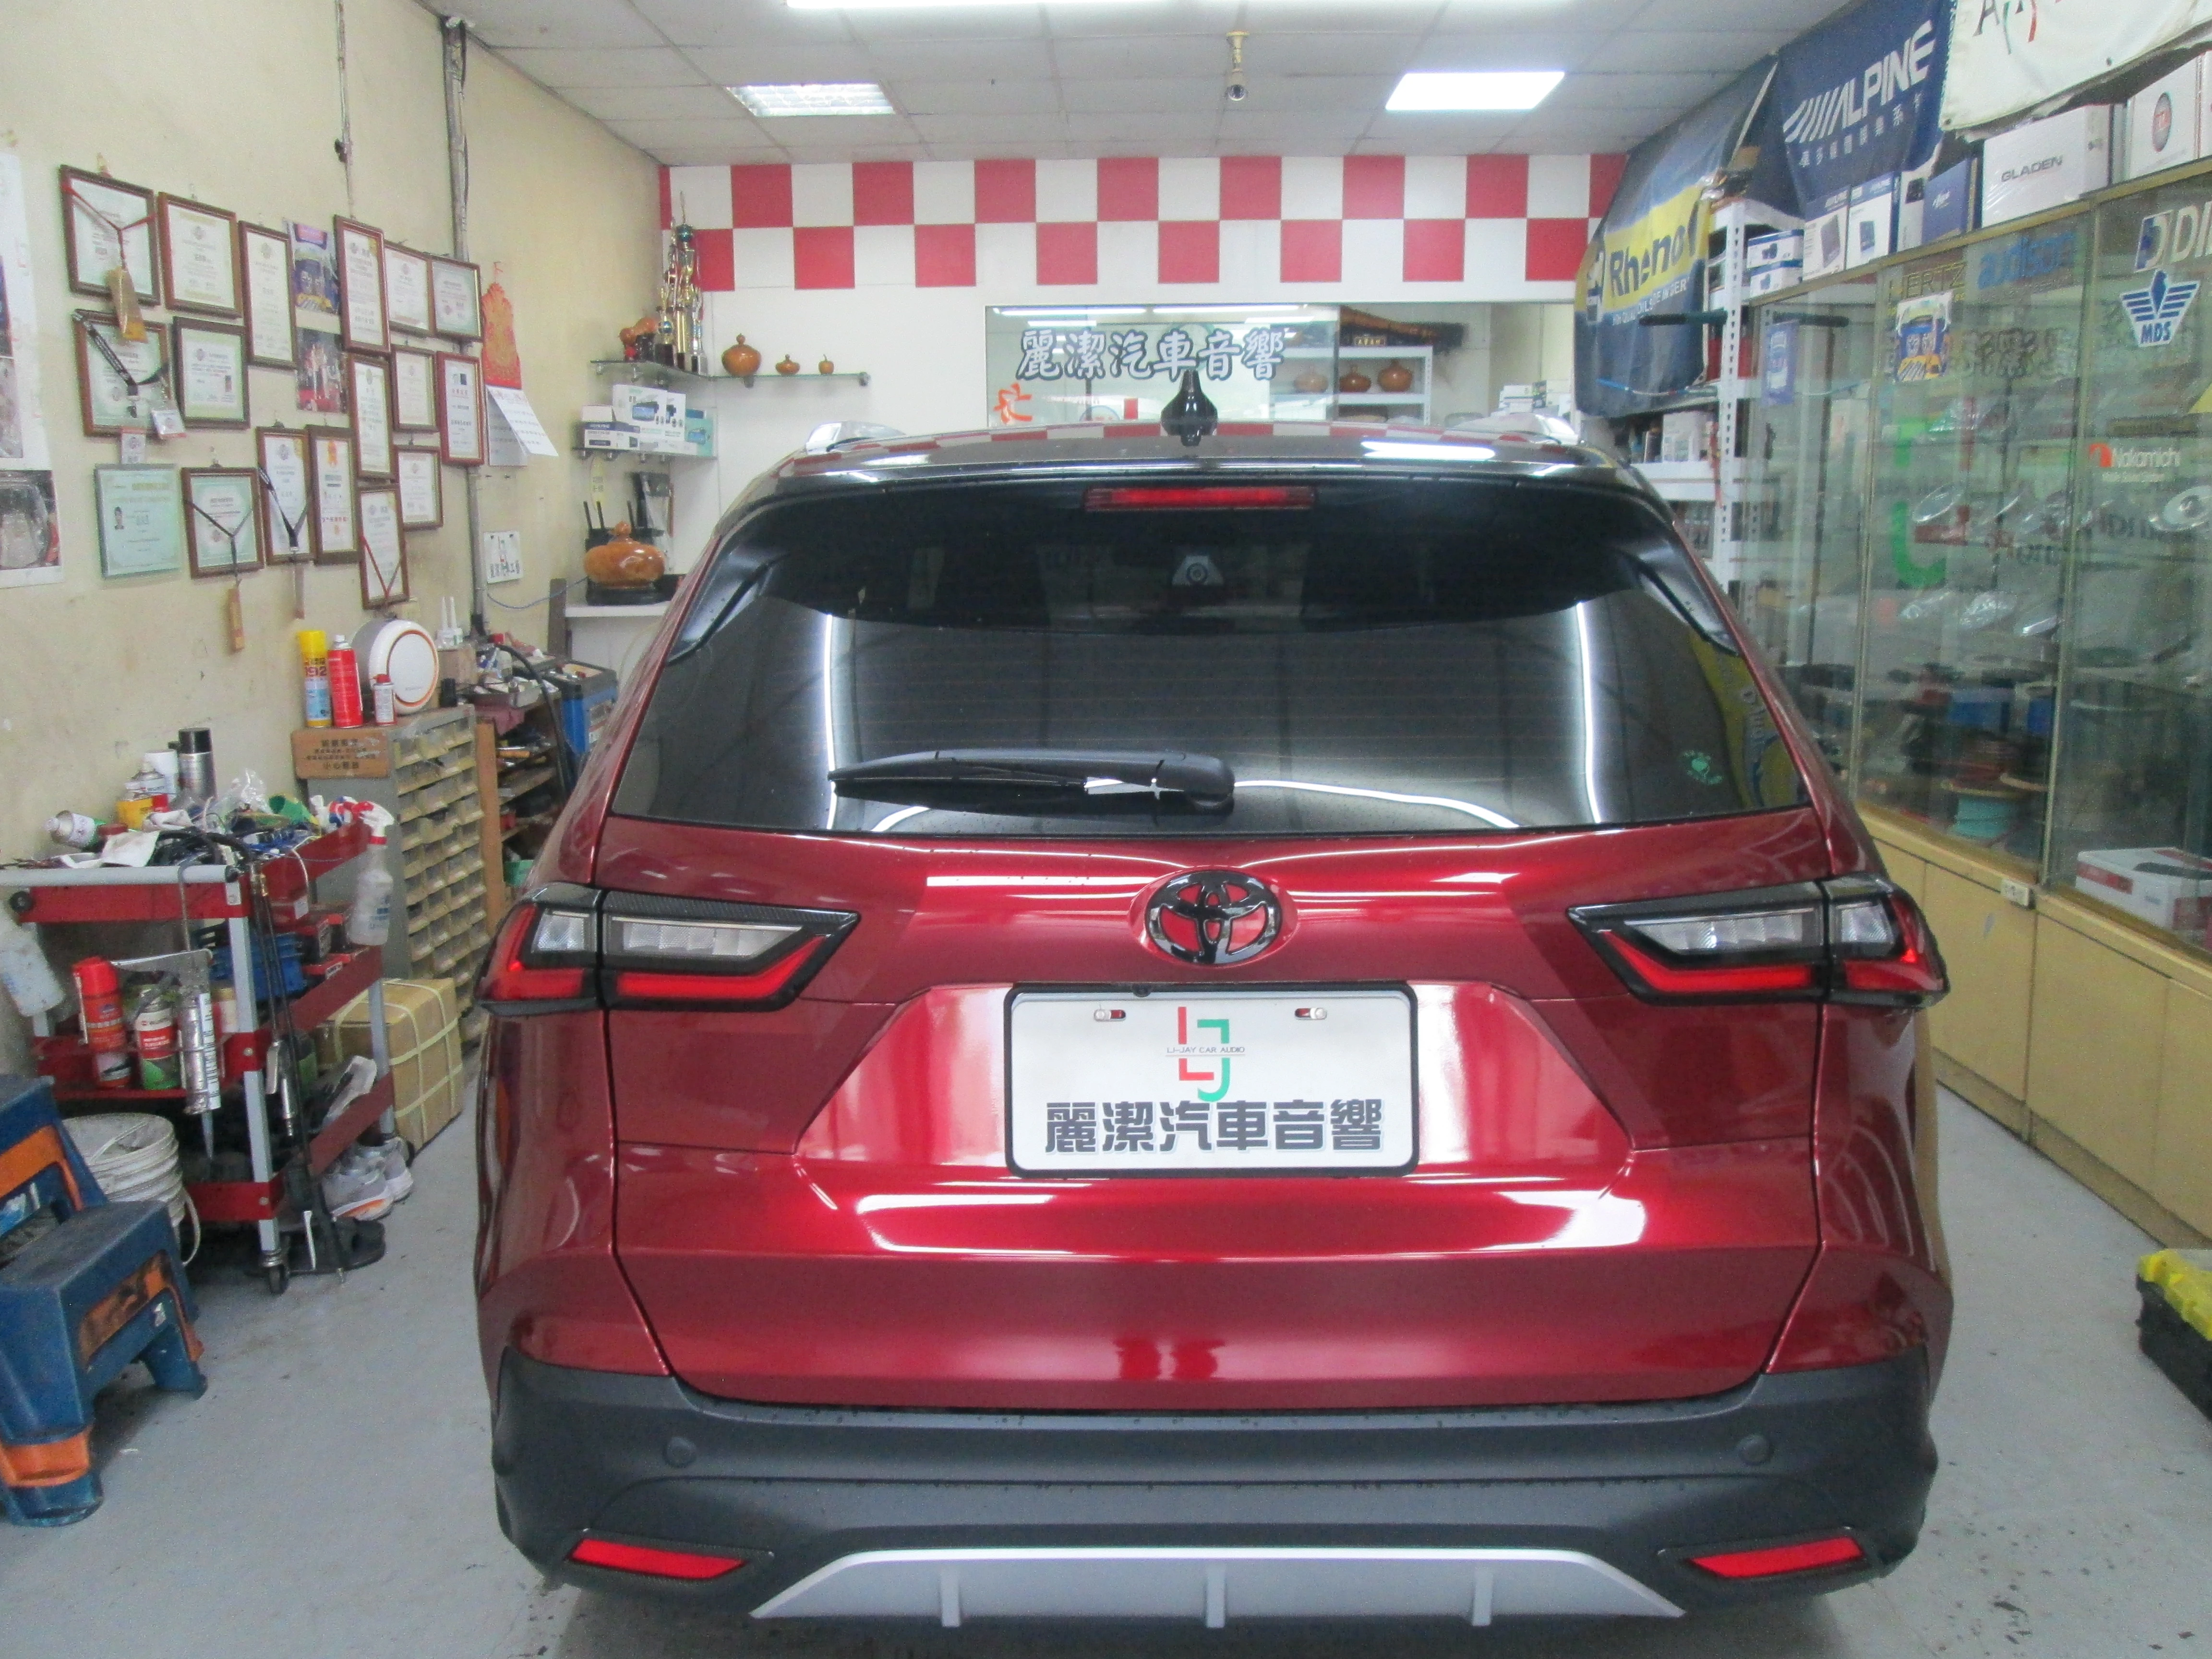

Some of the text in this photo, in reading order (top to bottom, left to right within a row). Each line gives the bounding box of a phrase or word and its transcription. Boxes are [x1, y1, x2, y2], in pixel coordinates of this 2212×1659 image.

[1810, 20, 1936, 137] ALPINE
[2000, 155, 2063, 182] GLADEN
[1016, 327, 1287, 382] 麗潔汽車音響
[2140, 321, 2172, 344] MDS
[1045, 1099, 1382, 1153] 麗潔汽車音響
